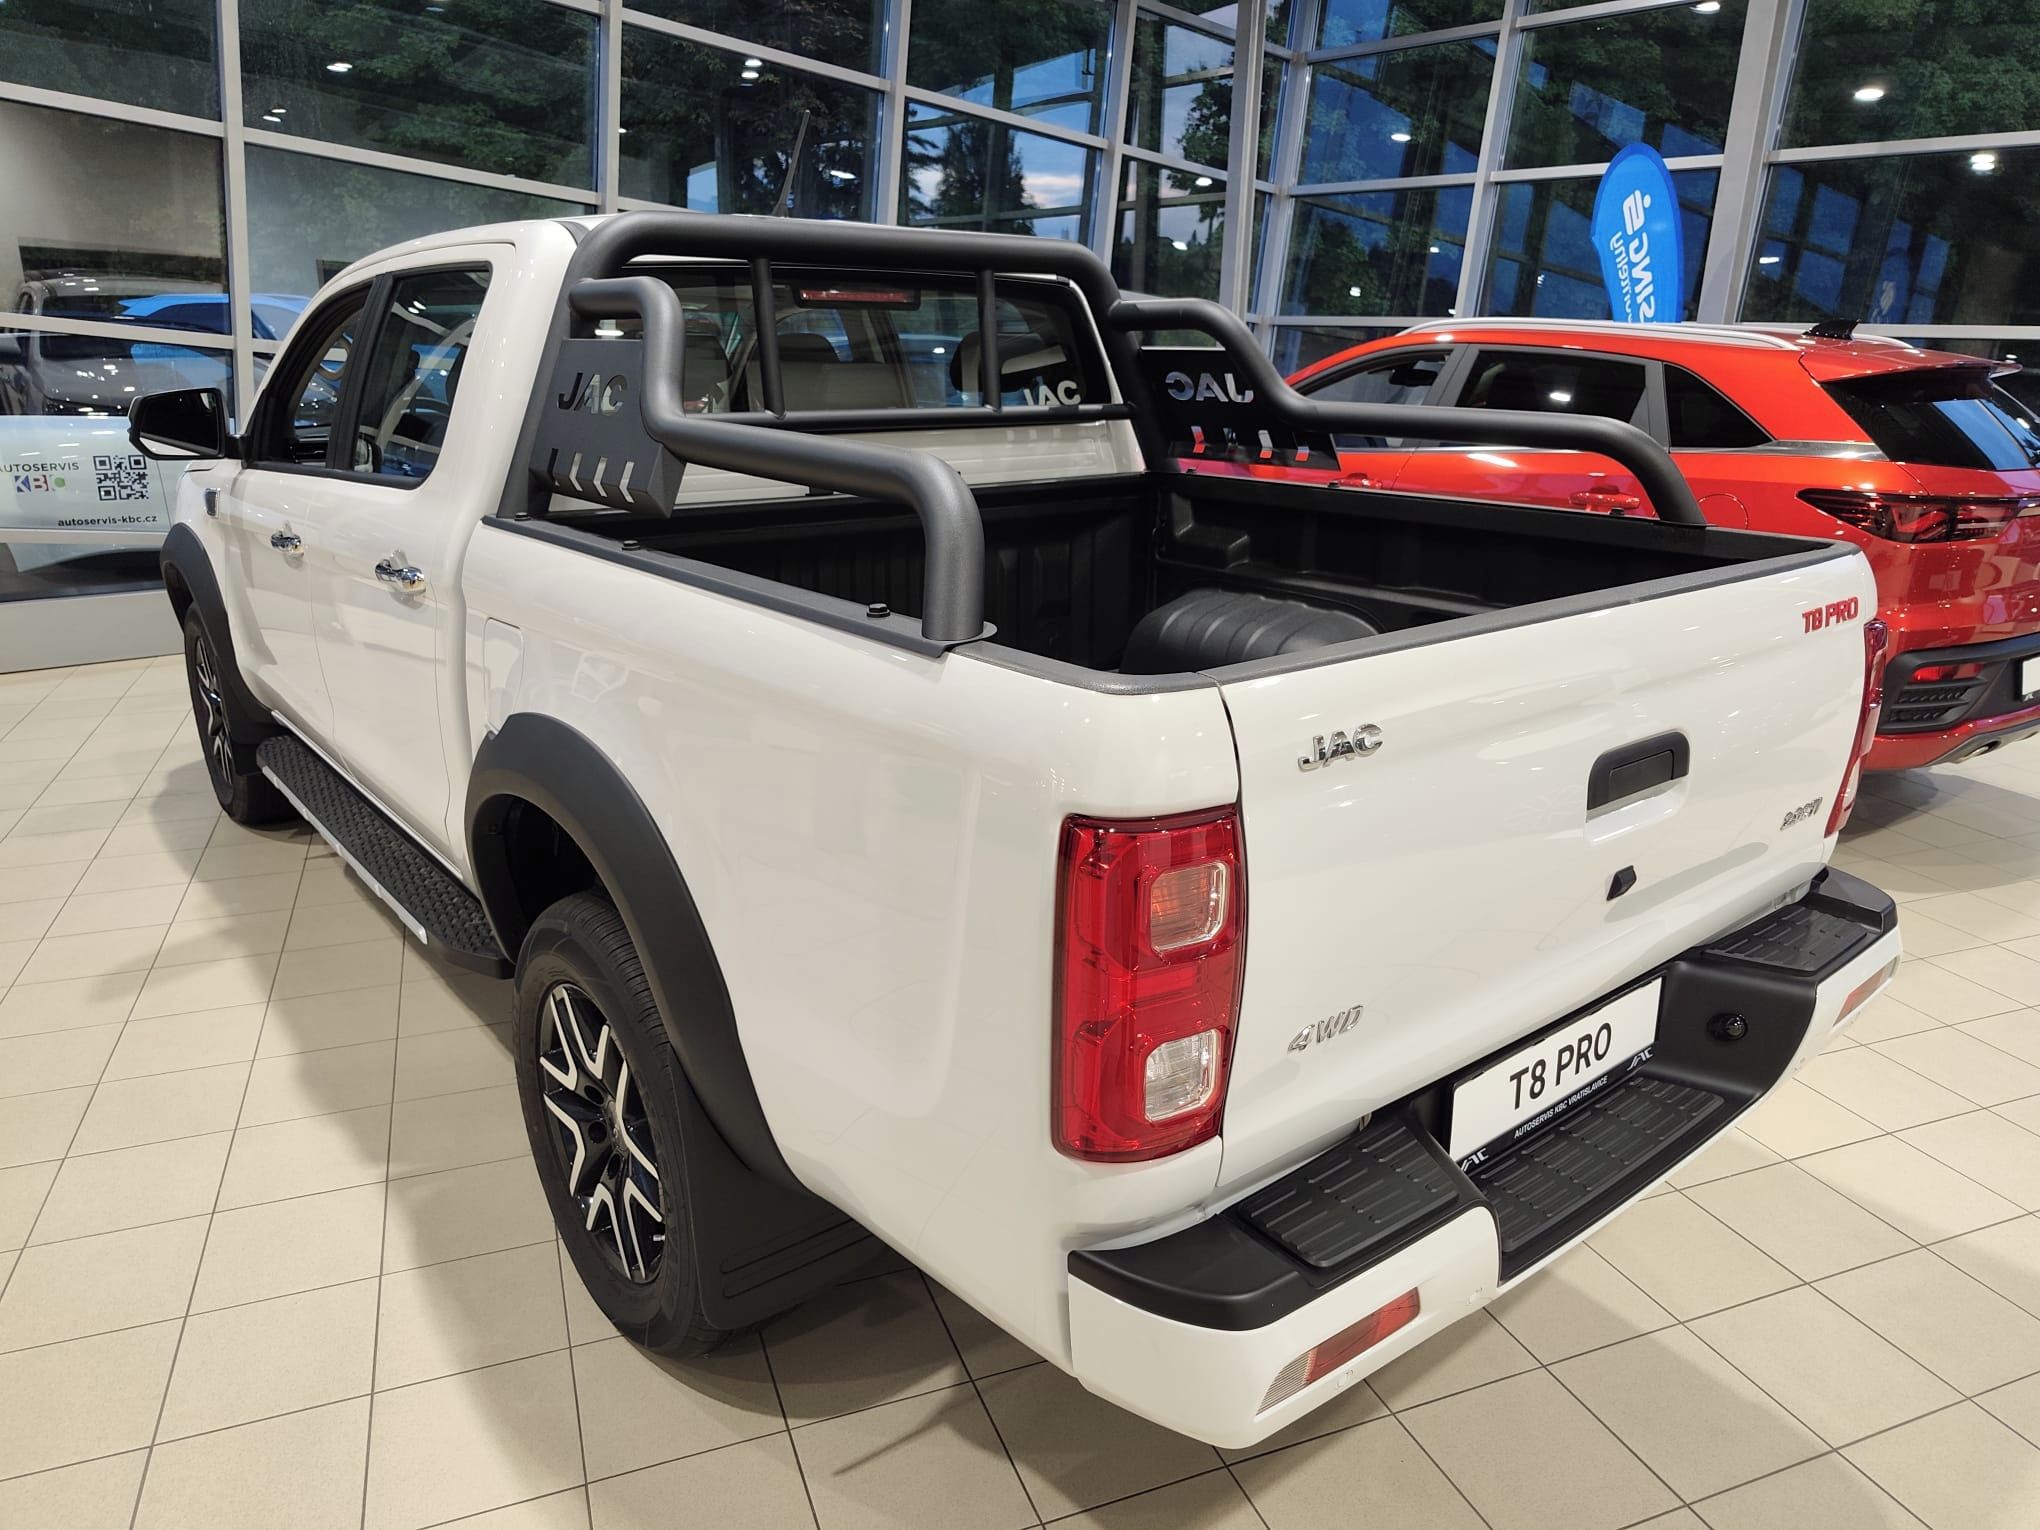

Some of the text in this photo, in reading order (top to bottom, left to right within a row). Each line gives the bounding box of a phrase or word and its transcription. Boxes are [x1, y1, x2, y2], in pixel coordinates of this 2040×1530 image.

[557, 372, 628, 416] JAC
[58, 514, 158, 527] autoservis-kbc.cz
[1802, 596, 1859, 634] T8 PRO
[1297, 723, 1384, 773] JAC
[1287, 1005, 1363, 1051] 4WD
[1509, 1022, 1612, 1111] T8 PRO
[1513, 1075, 1608, 1139] AUTOSERVIS KBC VRATISLAVICE
